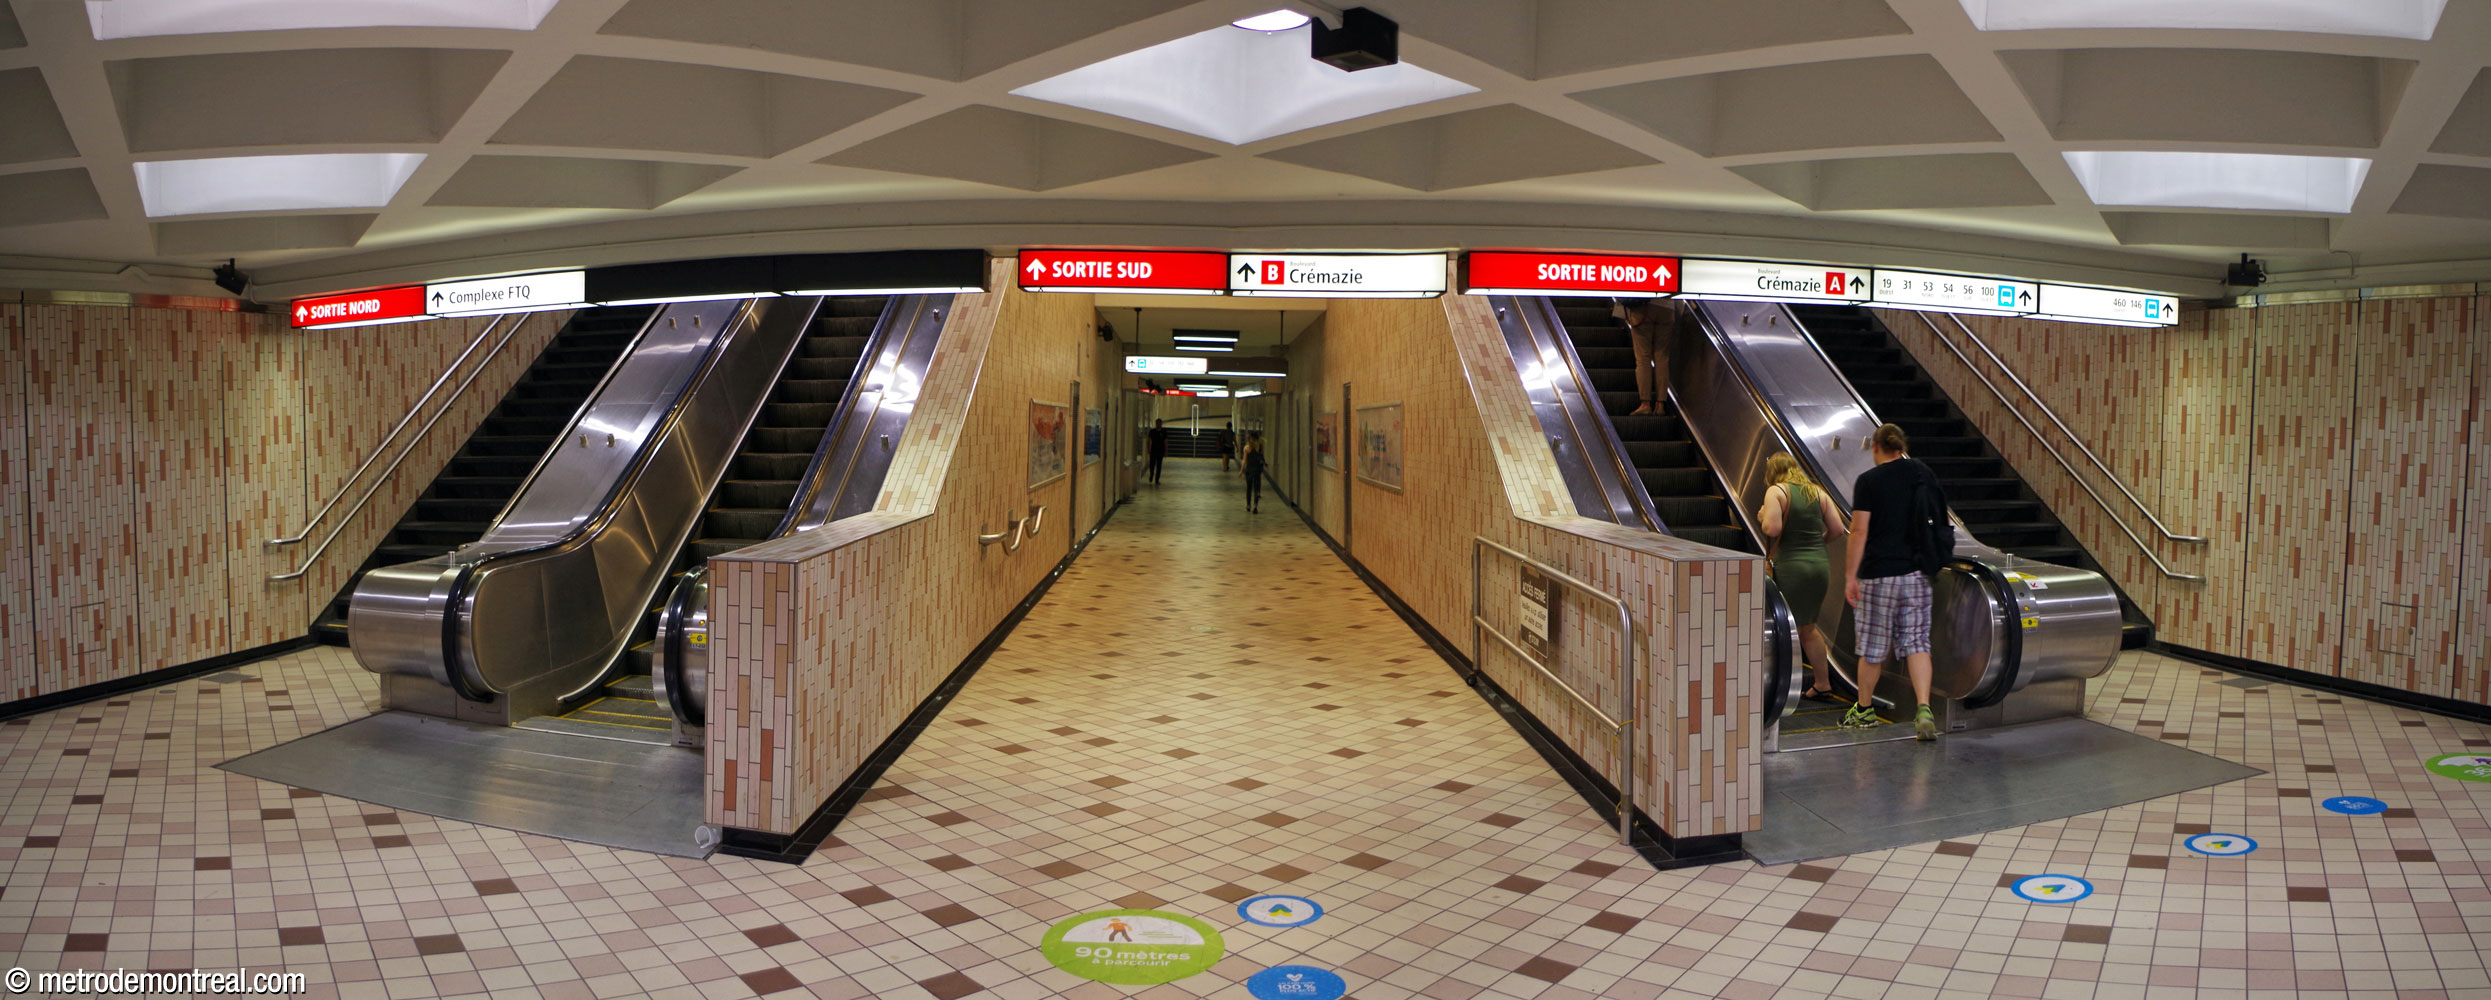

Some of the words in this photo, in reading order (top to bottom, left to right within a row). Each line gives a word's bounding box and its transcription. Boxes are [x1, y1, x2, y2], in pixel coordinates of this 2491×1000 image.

[1052, 260, 1113, 279] SORTIE
[1117, 261, 1153, 280] SUD
[1267, 264, 1279, 281] B
[1289, 268, 1363, 285] Crémazie
[1537, 263, 1597, 282] SORTIE
[1600, 265, 1648, 283] NORD
[1757, 275, 1821, 293] Crémazie
[1829, 276, 1841, 292] A
[1882, 278, 1892, 289] 19
[1902, 279, 1912, 290] 31
[1923, 281, 1934, 292] 53
[1943, 283, 1954, 293] 54
[1963, 285, 1973, 295] 56
[1981, 286, 1995, 297] 100
[449, 288, 504, 304] Complexe
[508, 285, 531, 300] FTQ
[311, 301, 347, 320] SORTIE
[349, 298, 381, 315] NORD
[2113, 298, 2127, 307] 460
[2130, 299, 2143, 309] 146
[1075, 947, 1113, 958] 90
[1116, 949, 1191, 961] mètres
[1104, 959, 1171, 967] parcourir
